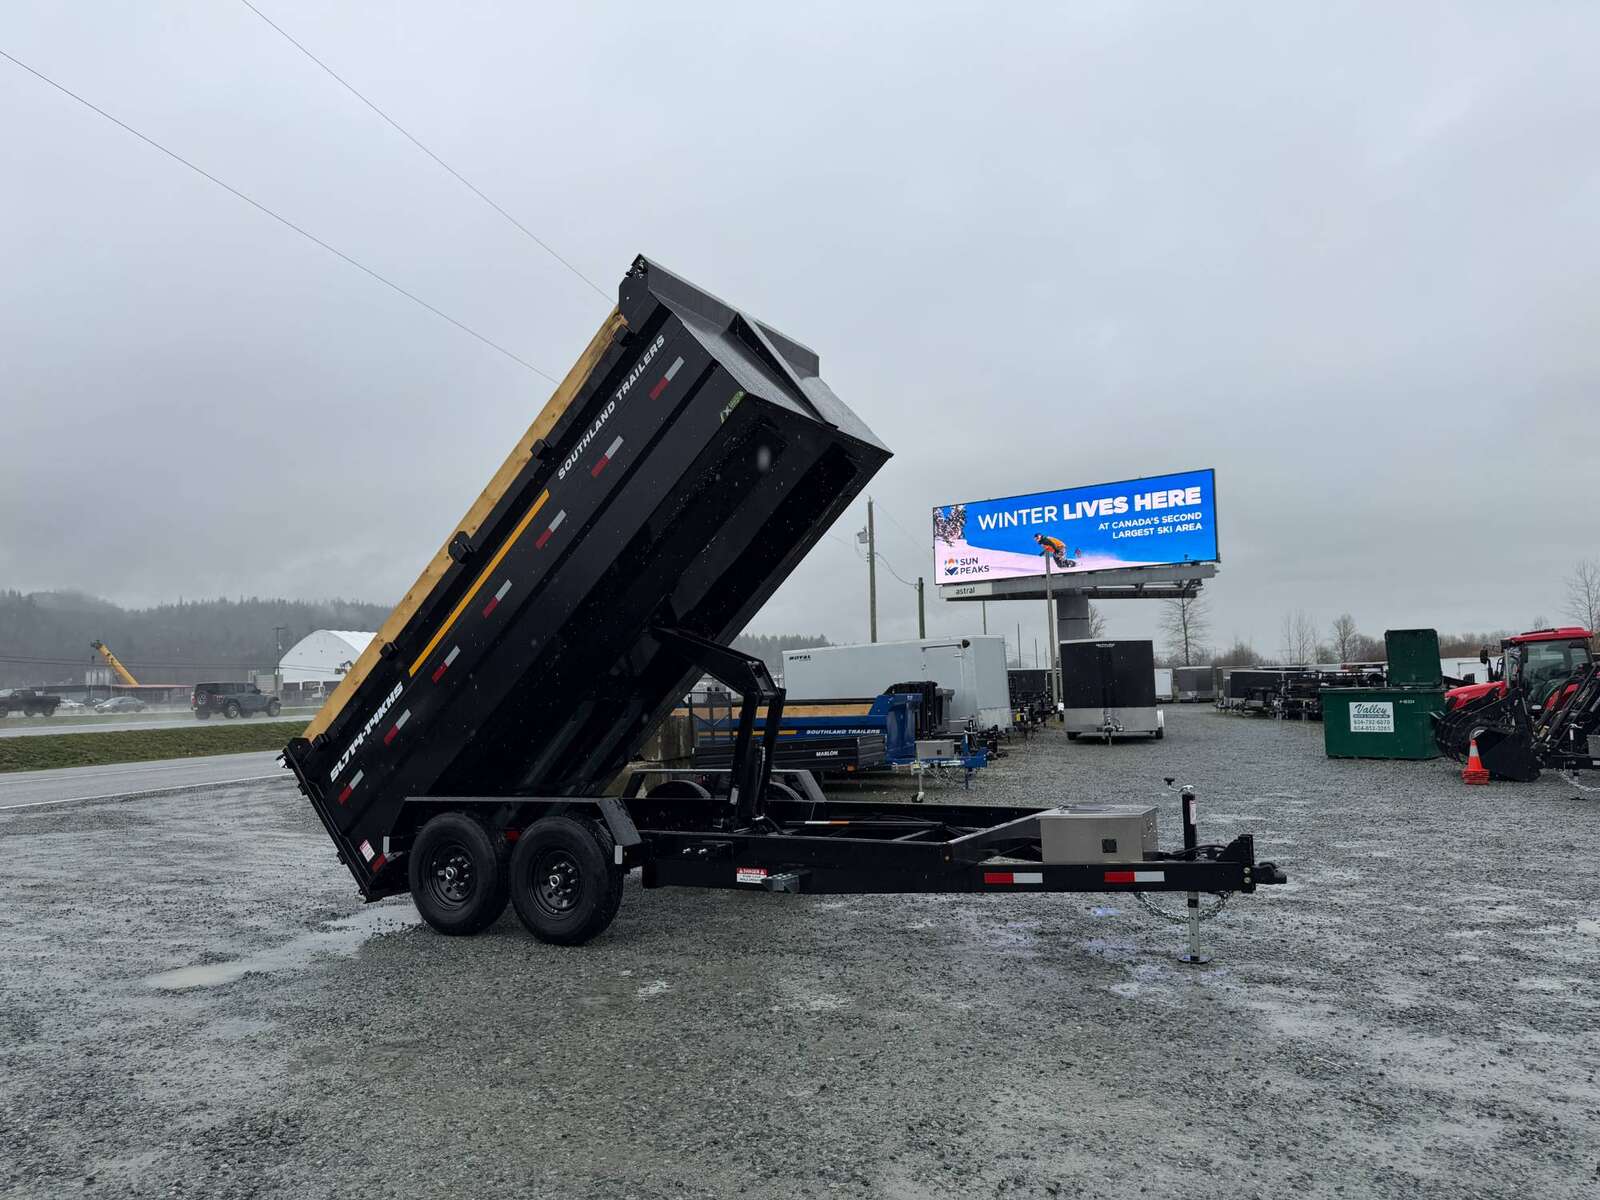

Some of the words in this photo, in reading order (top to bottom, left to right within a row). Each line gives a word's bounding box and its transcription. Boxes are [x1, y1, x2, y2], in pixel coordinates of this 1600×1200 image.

[558, 402, 616, 480] SOUTHLAND
[615, 334, 665, 400] TRAILERS
[977, 505, 1058, 530] WINTER
[1063, 496, 1129, 520] LIVES
[1134, 486, 1202, 511] HERE
[1098, 522, 1110, 531] AT
[1111, 516, 1160, 529] CANADA'S
[1161, 511, 1202, 523] SECOND
[1112, 527, 1155, 539] LARGEST
[1157, 526, 1173, 534] SKI
[1175, 522, 1203, 533] AREA
[960, 556, 979, 566] SUN
[960, 565, 990, 575] PEAKS
[955, 586, 976, 595] astral
[1354, 703, 1388, 714] Valley
[330, 680, 404, 783] SL714-14KHS
